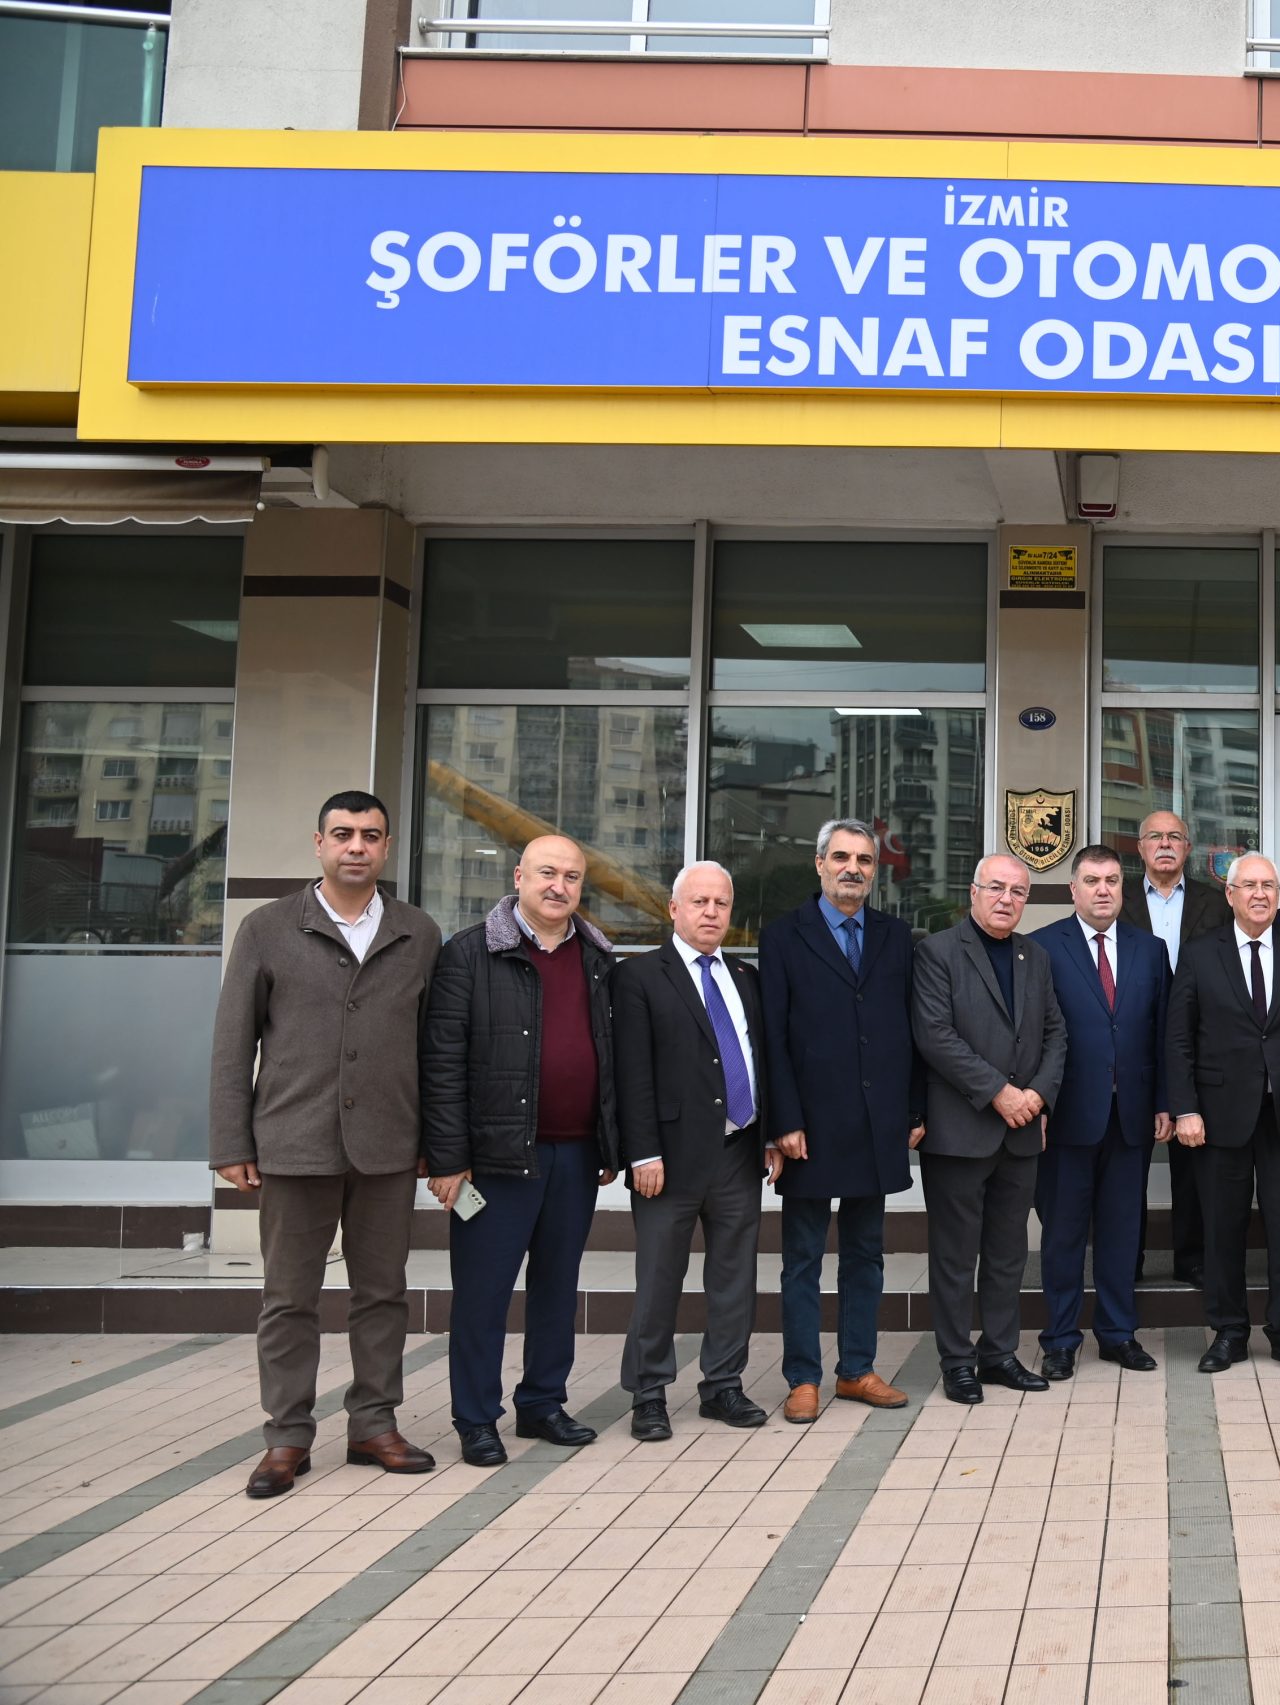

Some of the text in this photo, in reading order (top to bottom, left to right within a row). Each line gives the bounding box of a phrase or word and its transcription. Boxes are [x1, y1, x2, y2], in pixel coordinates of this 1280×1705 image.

[944, 184, 1069, 227] İZMİR
[366, 215, 797, 309] ŞOFÖRLER
[823, 236, 927, 296] VE
[722, 315, 989, 377] ESNAF
[1028, 712, 1046, 723] 158
